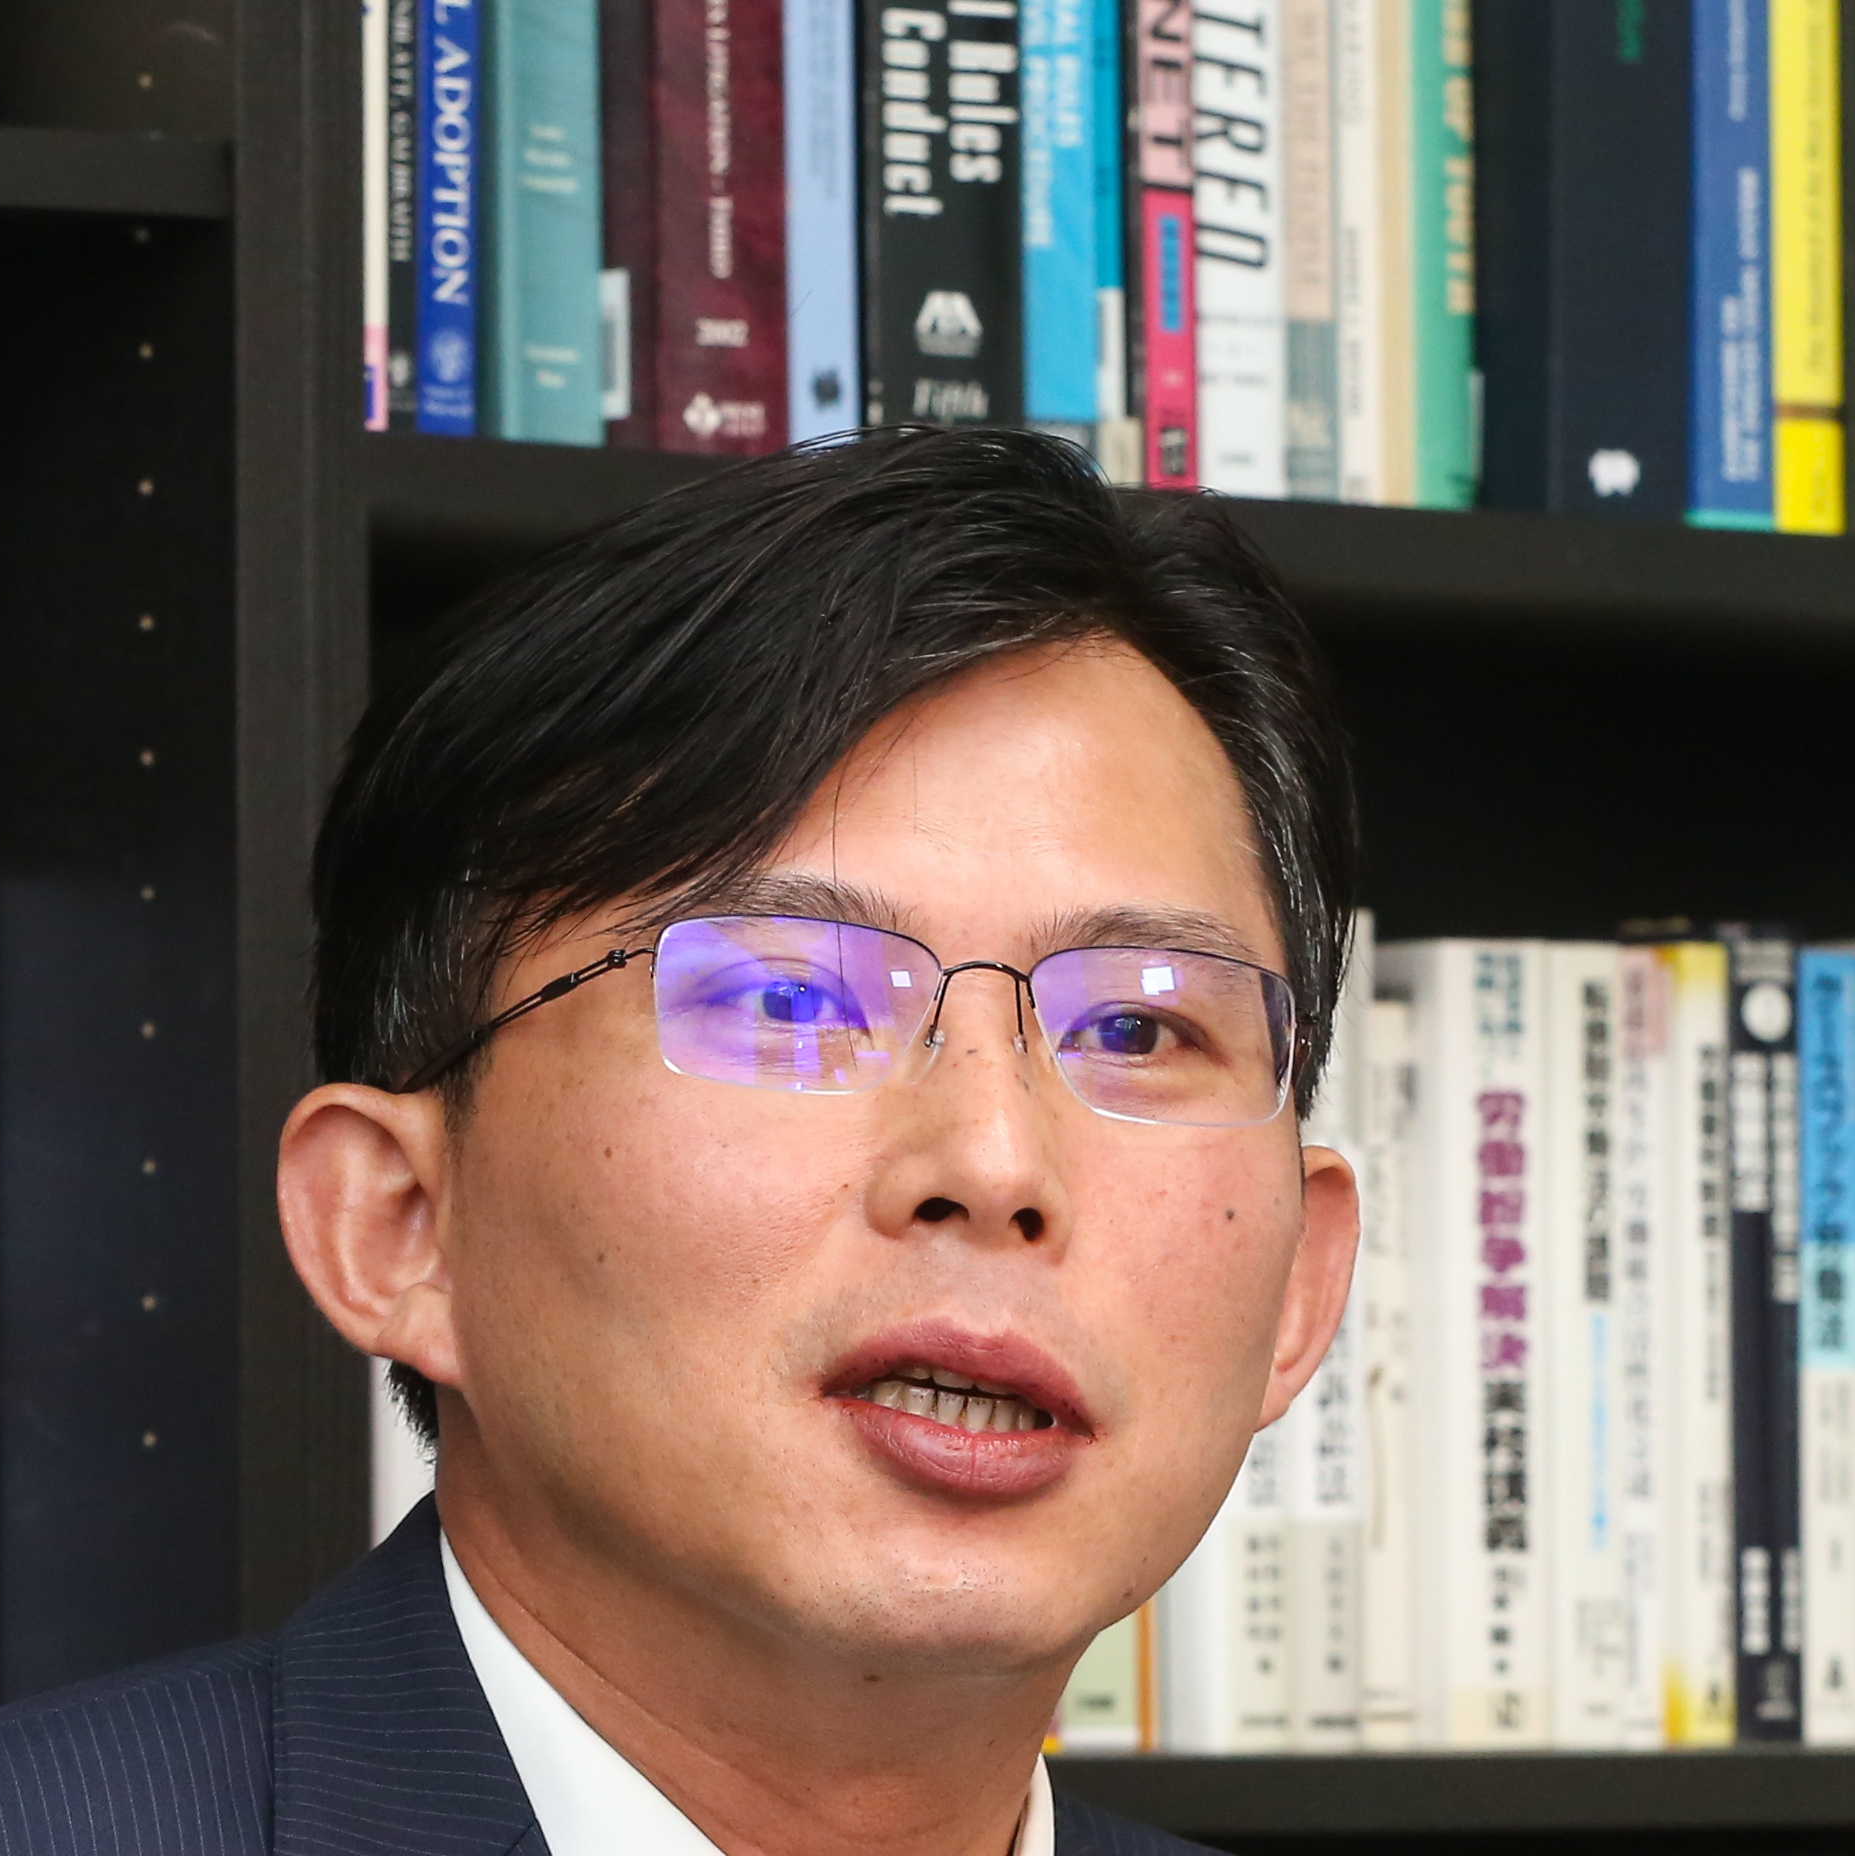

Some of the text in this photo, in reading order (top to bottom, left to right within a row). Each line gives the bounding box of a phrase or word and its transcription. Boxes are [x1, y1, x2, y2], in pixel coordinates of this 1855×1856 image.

[433, 36, 471, 304] ADOPTION
[882, 8, 947, 214] Conduct
[948, 39, 1019, 183] Rules
